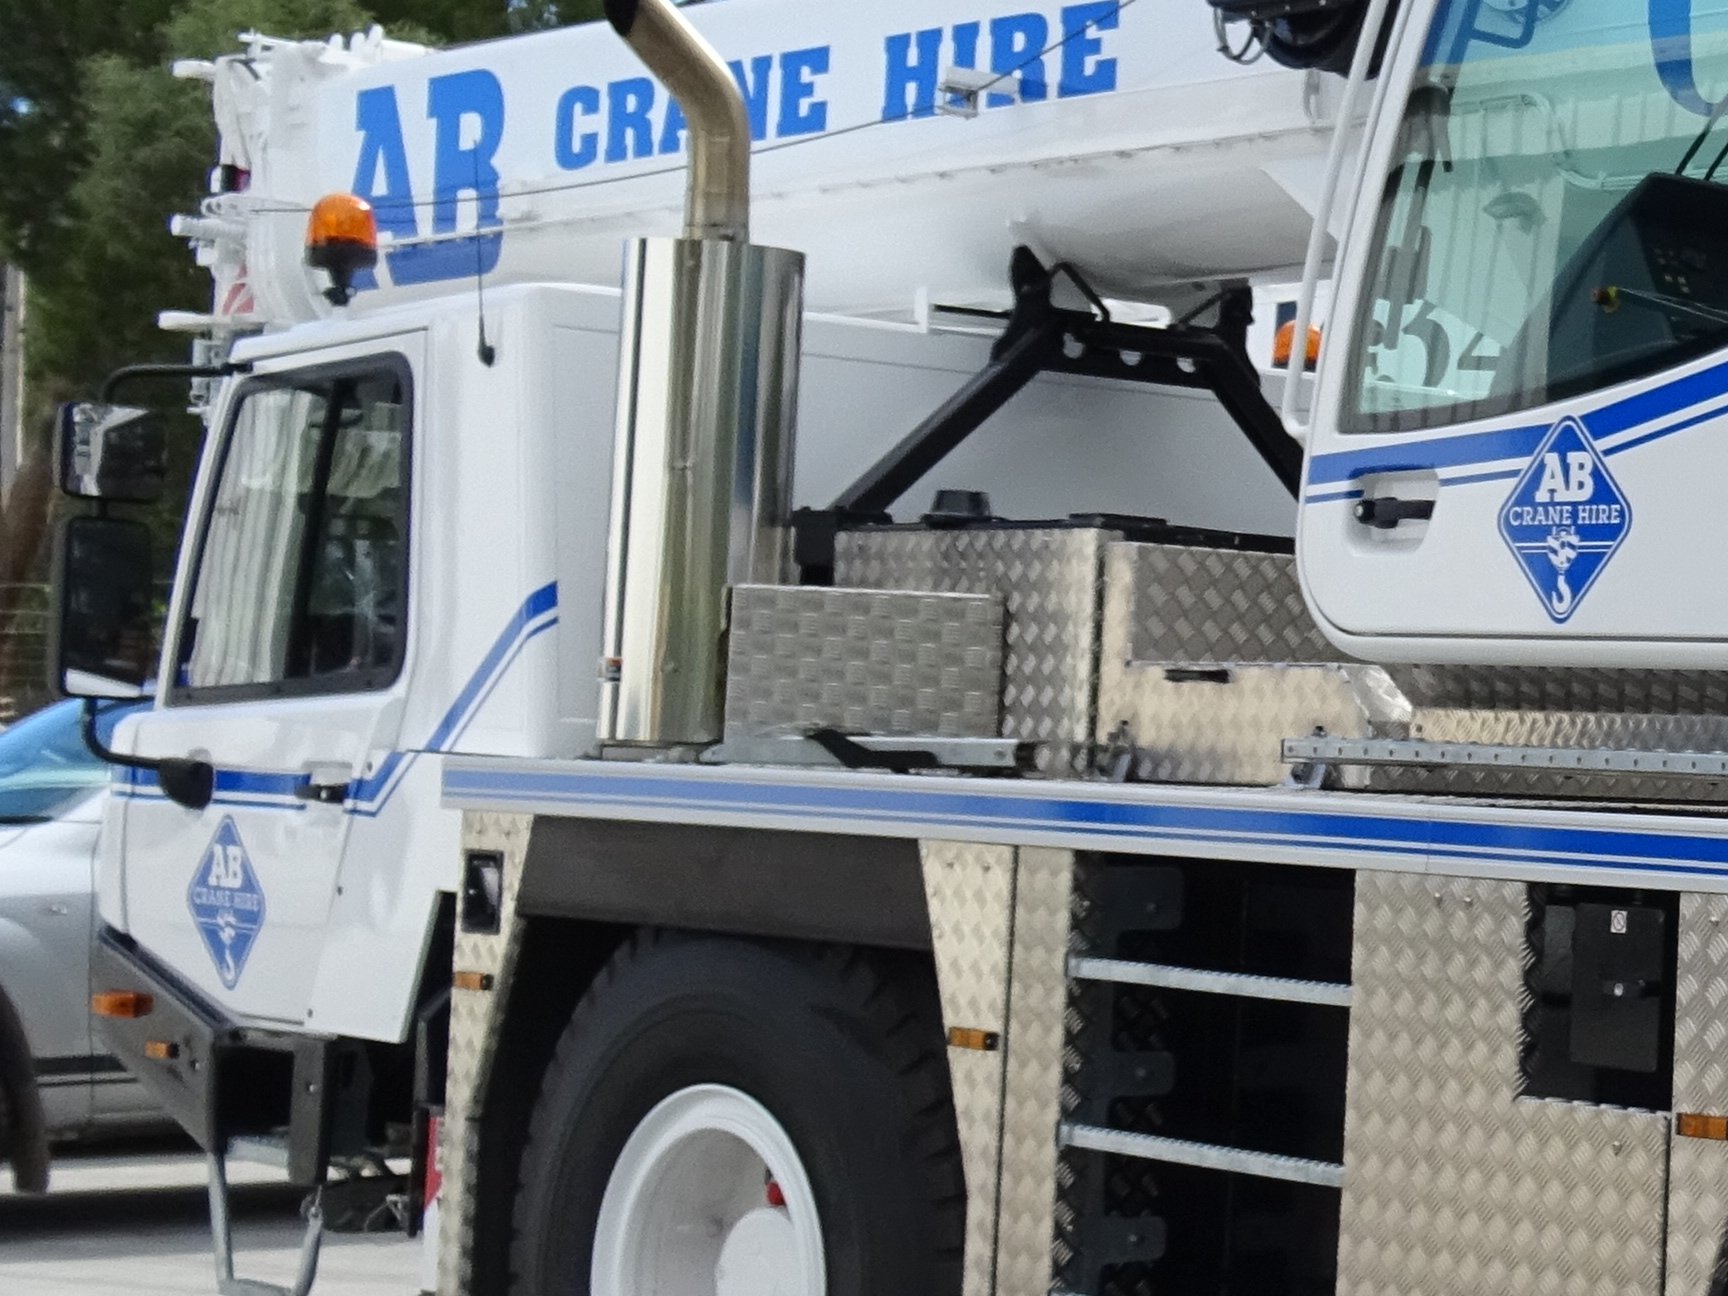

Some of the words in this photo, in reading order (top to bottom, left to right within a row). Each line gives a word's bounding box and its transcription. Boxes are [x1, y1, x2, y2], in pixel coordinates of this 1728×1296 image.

[352, 68, 506, 292] AB
[1534, 450, 1595, 503] AB
[1508, 505, 1573, 526] CRANE
[1576, 504, 1621, 525] HIRE
[208, 842, 244, 889] AB
